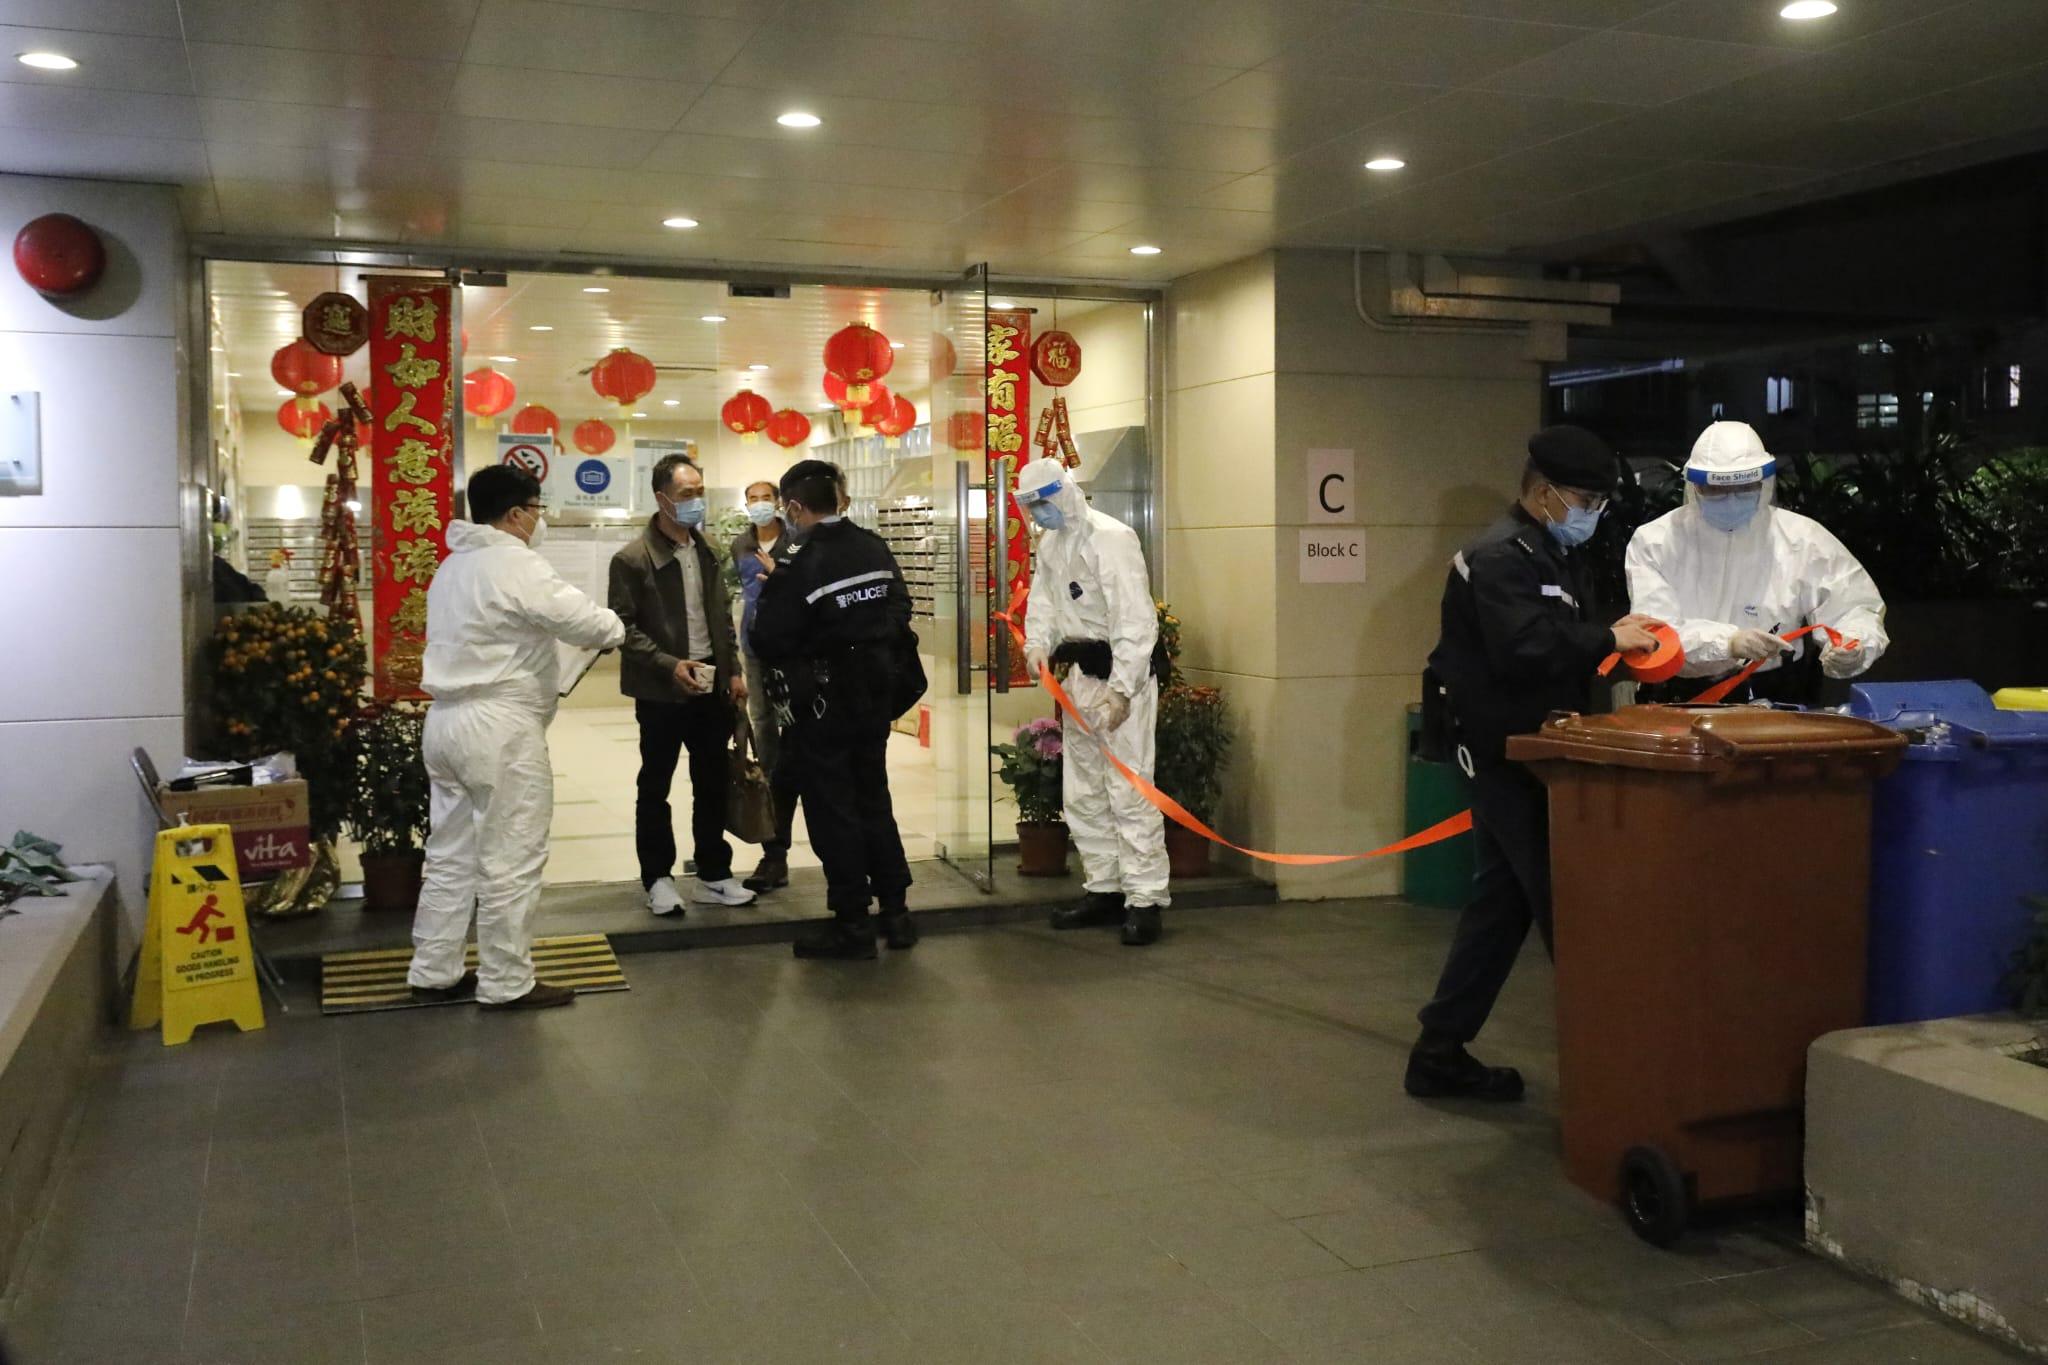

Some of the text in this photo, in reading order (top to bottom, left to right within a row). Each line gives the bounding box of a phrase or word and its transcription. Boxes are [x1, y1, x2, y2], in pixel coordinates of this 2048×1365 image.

[1047, 341, 1072, 370] 福
[1711, 470, 1759, 482] Face Shield
[1319, 473, 1345, 514] C
[1307, 542, 1359, 558] Block C
[244, 833, 298, 860] vita
[190, 948, 222, 960] CAUTION
